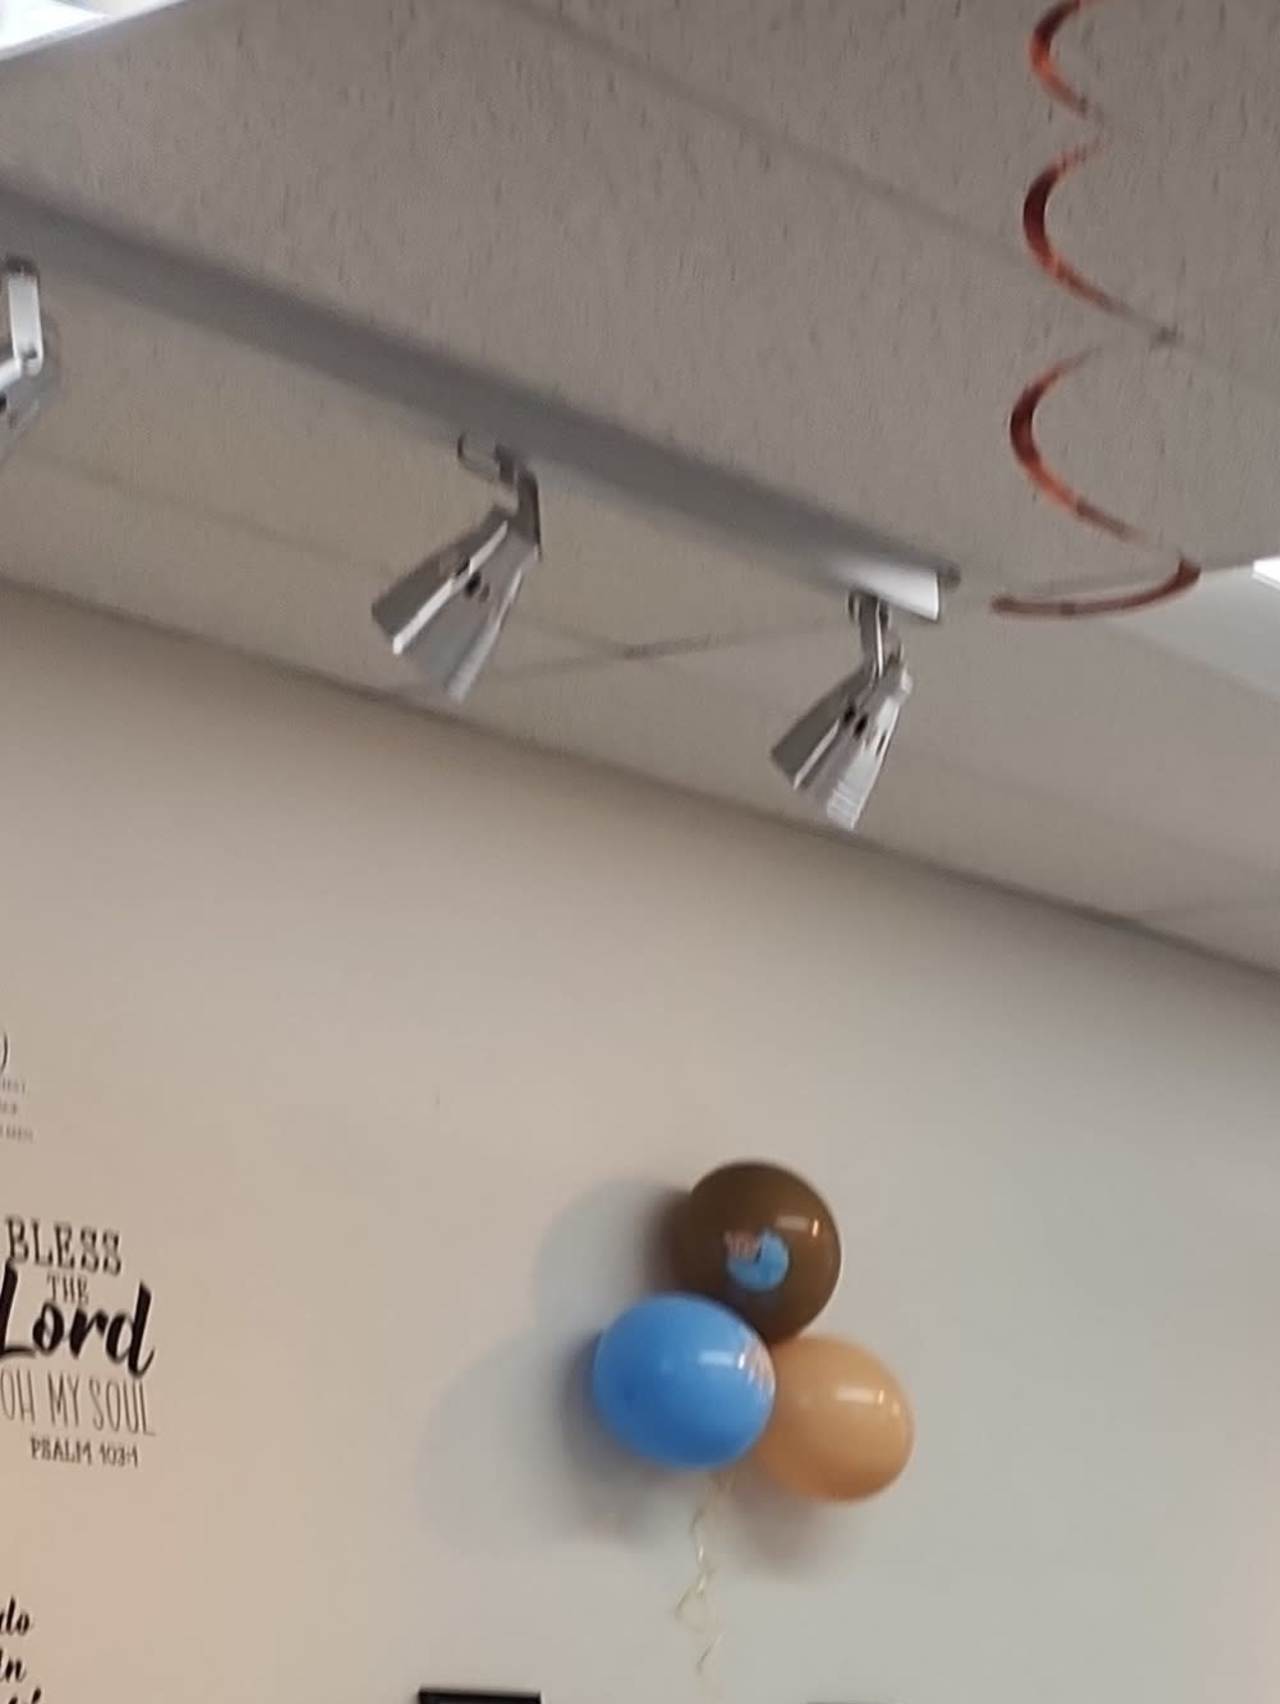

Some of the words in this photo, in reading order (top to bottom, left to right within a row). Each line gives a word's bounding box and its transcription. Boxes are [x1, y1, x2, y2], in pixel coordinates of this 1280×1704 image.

[6, 1214, 122, 1276] BLESS
[0, 1257, 155, 1379] Lord
[47, 1270, 88, 1305] THE
[0, 1367, 35, 1424] OH
[48, 1371, 79, 1428] MY
[89, 1376, 156, 1437] SOUL
[30, 1436, 92, 1467] PSALM
